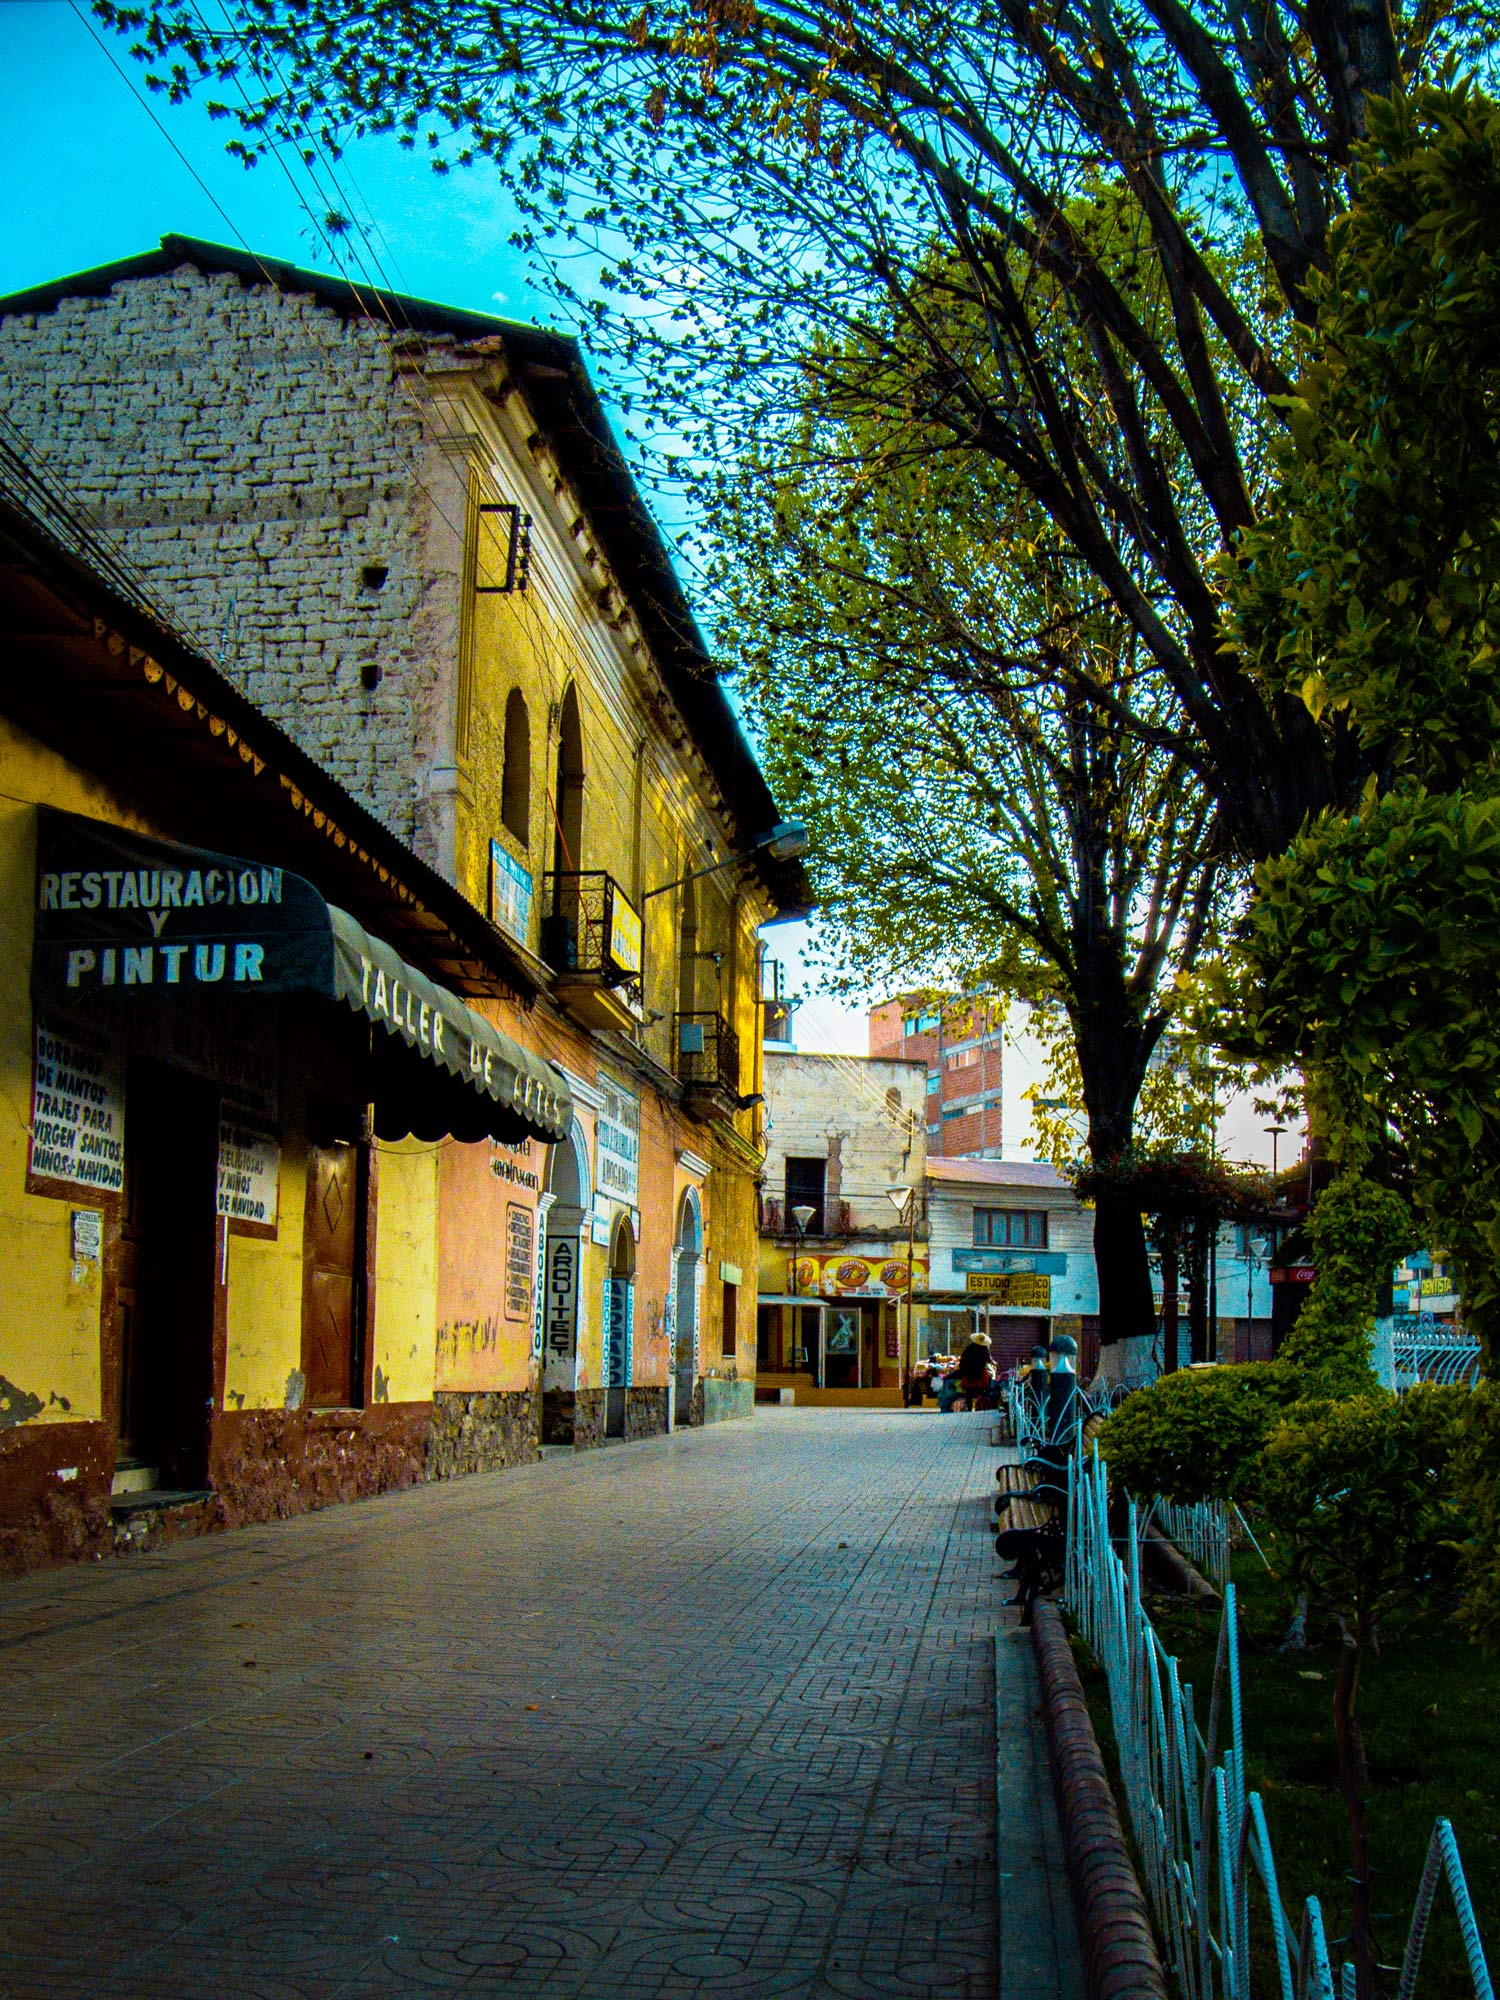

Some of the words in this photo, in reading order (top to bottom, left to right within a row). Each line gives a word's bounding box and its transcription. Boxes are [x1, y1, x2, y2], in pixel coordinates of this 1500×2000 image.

[41, 867, 283, 910] RESTAURACION
[147, 910, 171, 938] Y
[67, 944, 266, 987] PINTUR
[361, 955, 445, 1054] TALLER
[469, 1040, 492, 1084] DE
[38, 1062, 53, 1087] DE
[56, 1070, 107, 1105] MANTOS
[37, 1091, 80, 1123] TRAJES
[84, 1106, 112, 1133] PARA
[34, 1119, 76, 1149] VIRGEN
[77, 1158, 122, 1188] NAVIDAD
[219, 1171, 225, 1188] Y
[227, 1171, 251, 1194] NIÑOS
[219, 1193, 230, 1211] DE
[231, 1197, 265, 1219] NAVIDAD
[534, 1213, 544, 1350] ABOGADO
[970, 1277, 1010, 1288] ESTUDIO
[1421, 1277, 1451, 1296] DENTISTA
[609, 1281, 622, 1385] ABOGADO
